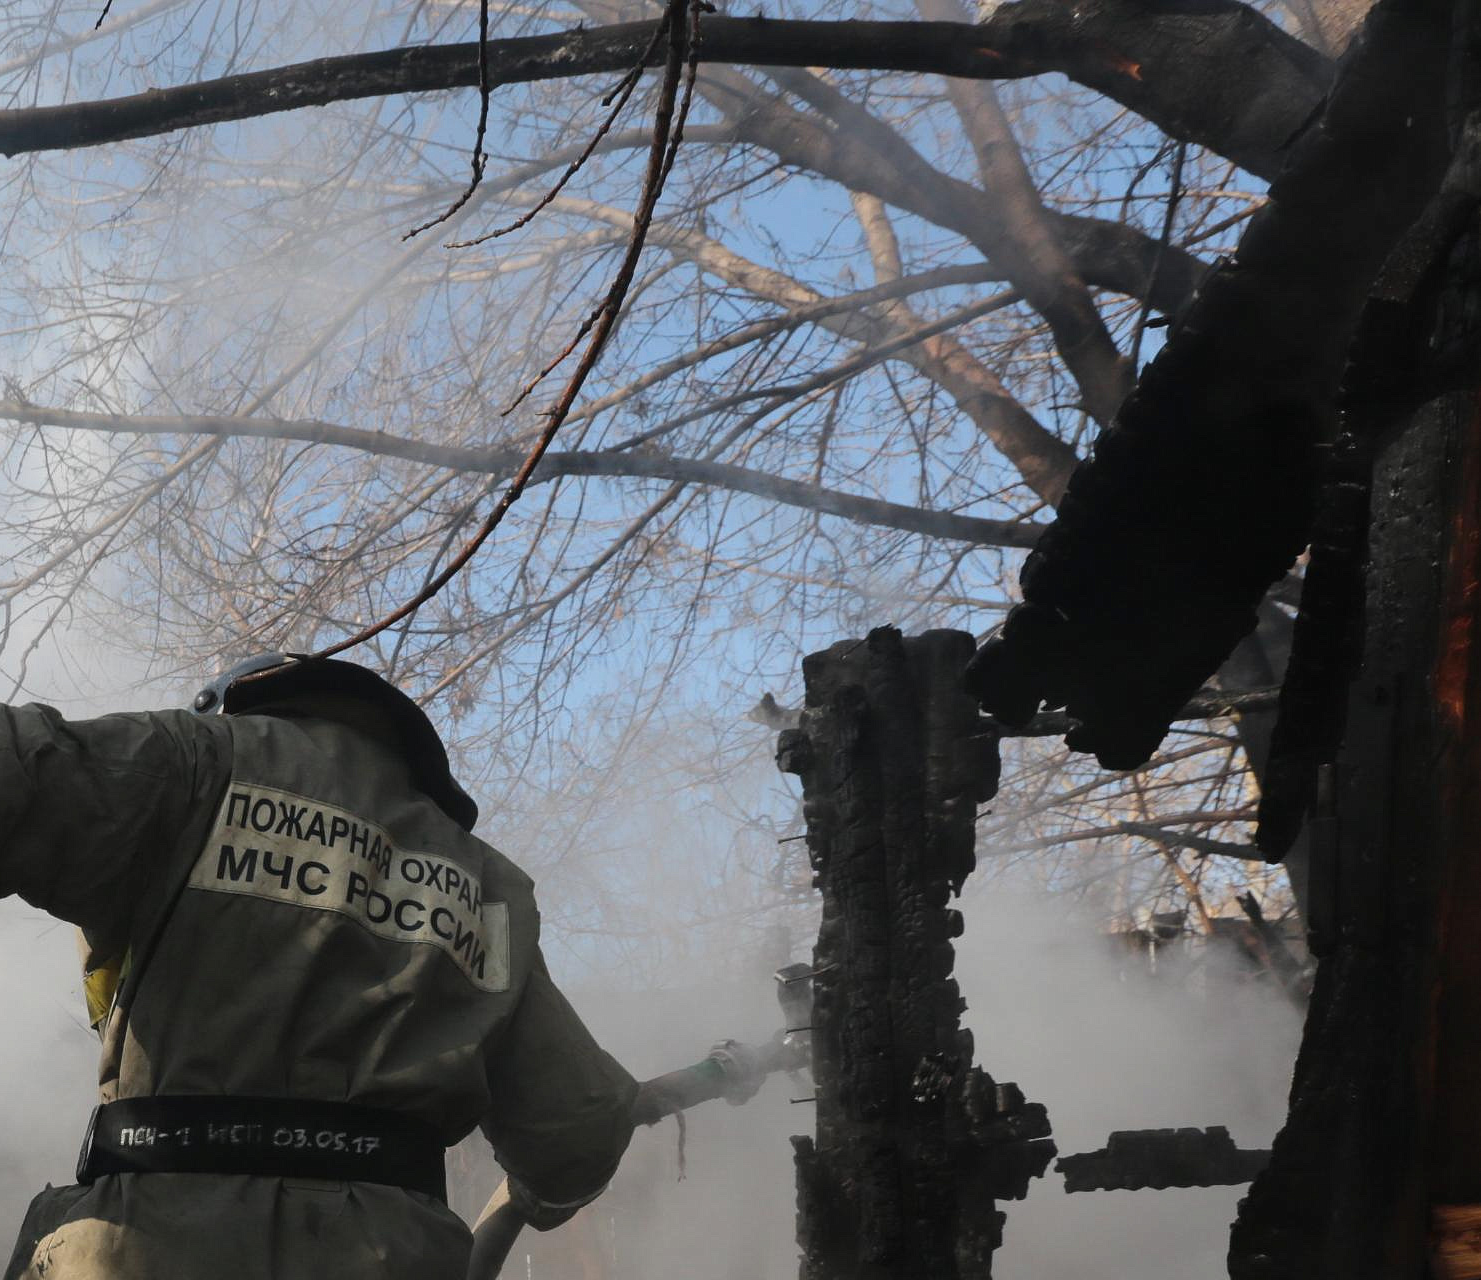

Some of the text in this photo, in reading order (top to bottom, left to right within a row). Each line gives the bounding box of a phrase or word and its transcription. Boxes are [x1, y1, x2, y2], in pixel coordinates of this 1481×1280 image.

[216, 844, 486, 980] МЧС РОССИИ
[225, 792, 484, 922] ПОЖАРНАЯ ОХРАН
[273, 1127, 381, 1154] 03.05.17
